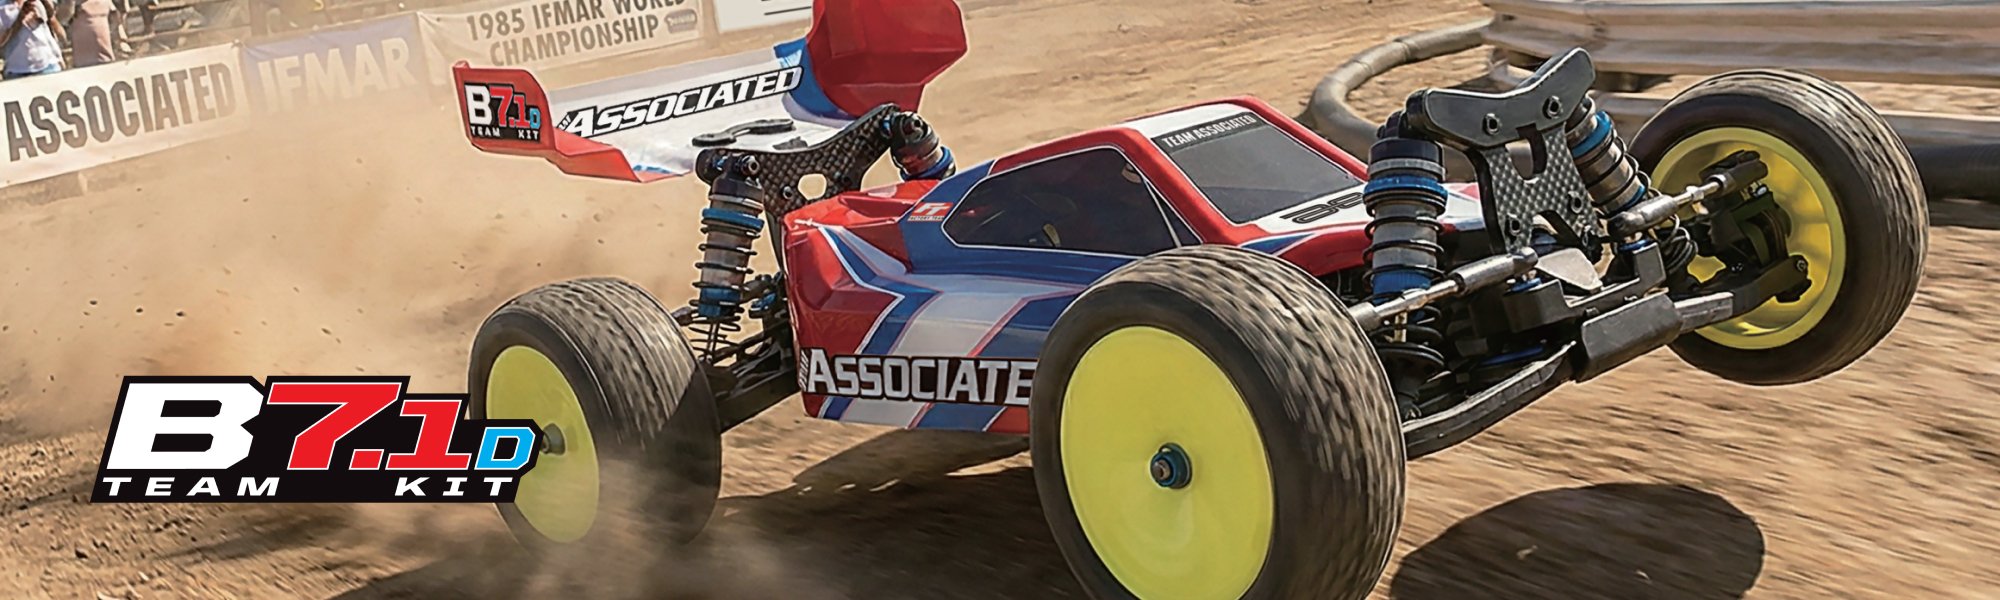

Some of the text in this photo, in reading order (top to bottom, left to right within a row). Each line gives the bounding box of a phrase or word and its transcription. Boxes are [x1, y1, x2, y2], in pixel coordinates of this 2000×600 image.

[466, 8, 525, 41] 1985
[532, 0, 605, 30] IFMAR
[490, 14, 659, 67] CHAMPIONSHIP
[258, 37, 417, 112] IFMAR
[4, 62, 237, 162] ASSOCIATED
[566, 67, 802, 138] ASSOCIATED
[471, 126, 539, 140] TEAM KIT
[1162, 115, 1257, 148] TEAM ASSOCIATED
